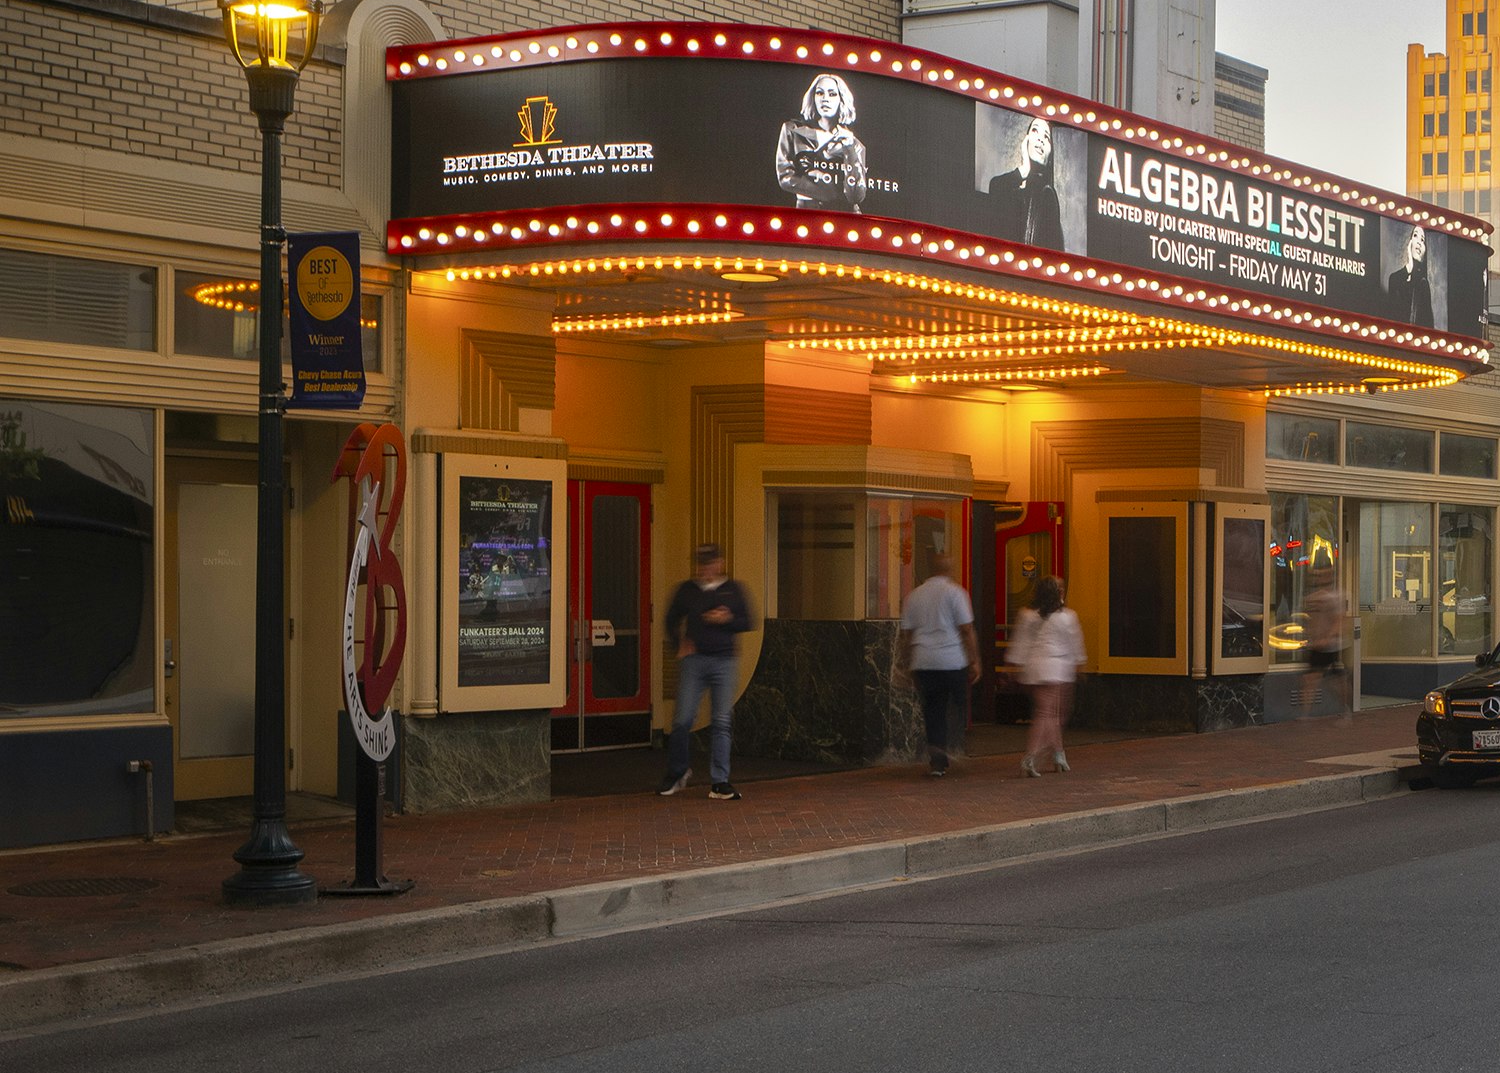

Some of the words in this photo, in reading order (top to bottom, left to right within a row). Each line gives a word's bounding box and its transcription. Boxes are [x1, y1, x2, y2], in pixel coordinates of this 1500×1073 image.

[443, 149, 545, 173] BETHESDA
[547, 143, 654, 164] THEATER
[582, 165, 605, 174] AND
[612, 163, 654, 173] MORE!
[813, 161, 853, 172] HOSTED
[814, 173, 838, 185] JOI
[847, 175, 899, 193] CARTER
[1098, 146, 1240, 224] ALGEBRA
[1247, 186, 1365, 254] BLESSETT
[1098, 197, 1143, 224] HOSTED
[1144, 209, 1160, 226] BY
[1159, 212, 1176, 232] JOI
[1177, 217, 1217, 242] CARTER
[1217, 227, 1244, 248] WITH
[1244, 234, 1282, 257] SPECIAL
[1283, 242, 1312, 264] GUEST
[1312, 248, 1334, 270] ALEX
[1335, 254, 1366, 277] HARRIS
[310, 259, 338, 274] BEST
[1150, 235, 1216, 272] TONIGHT
[1229, 254, 1279, 284] FRIDAY
[1281, 264, 1312, 291] MAY
[1314, 274, 1327, 296] 31
[318, 277, 329, 289] OF
[308, 334, 345, 345] Winner
[298, 370, 319, 381] Chevy
[320, 369, 342, 380] Chase
[343, 369, 362, 379] Acura
[304, 382, 320, 392] Best
[321, 382, 359, 393] Dealership
[470, 500, 506, 508] BETHESDA
[459, 627, 507, 636] FUNKATEER'S
[508, 627, 526, 636] BALL
[527, 627, 544, 636] 2024
[459, 638, 488, 646] SATURDAY
[489, 637, 520, 646] SEPTEMBER
[530, 637, 545, 645] 2024
[348, 671, 363, 731] ARTS
[364, 724, 388, 755] SHINE
